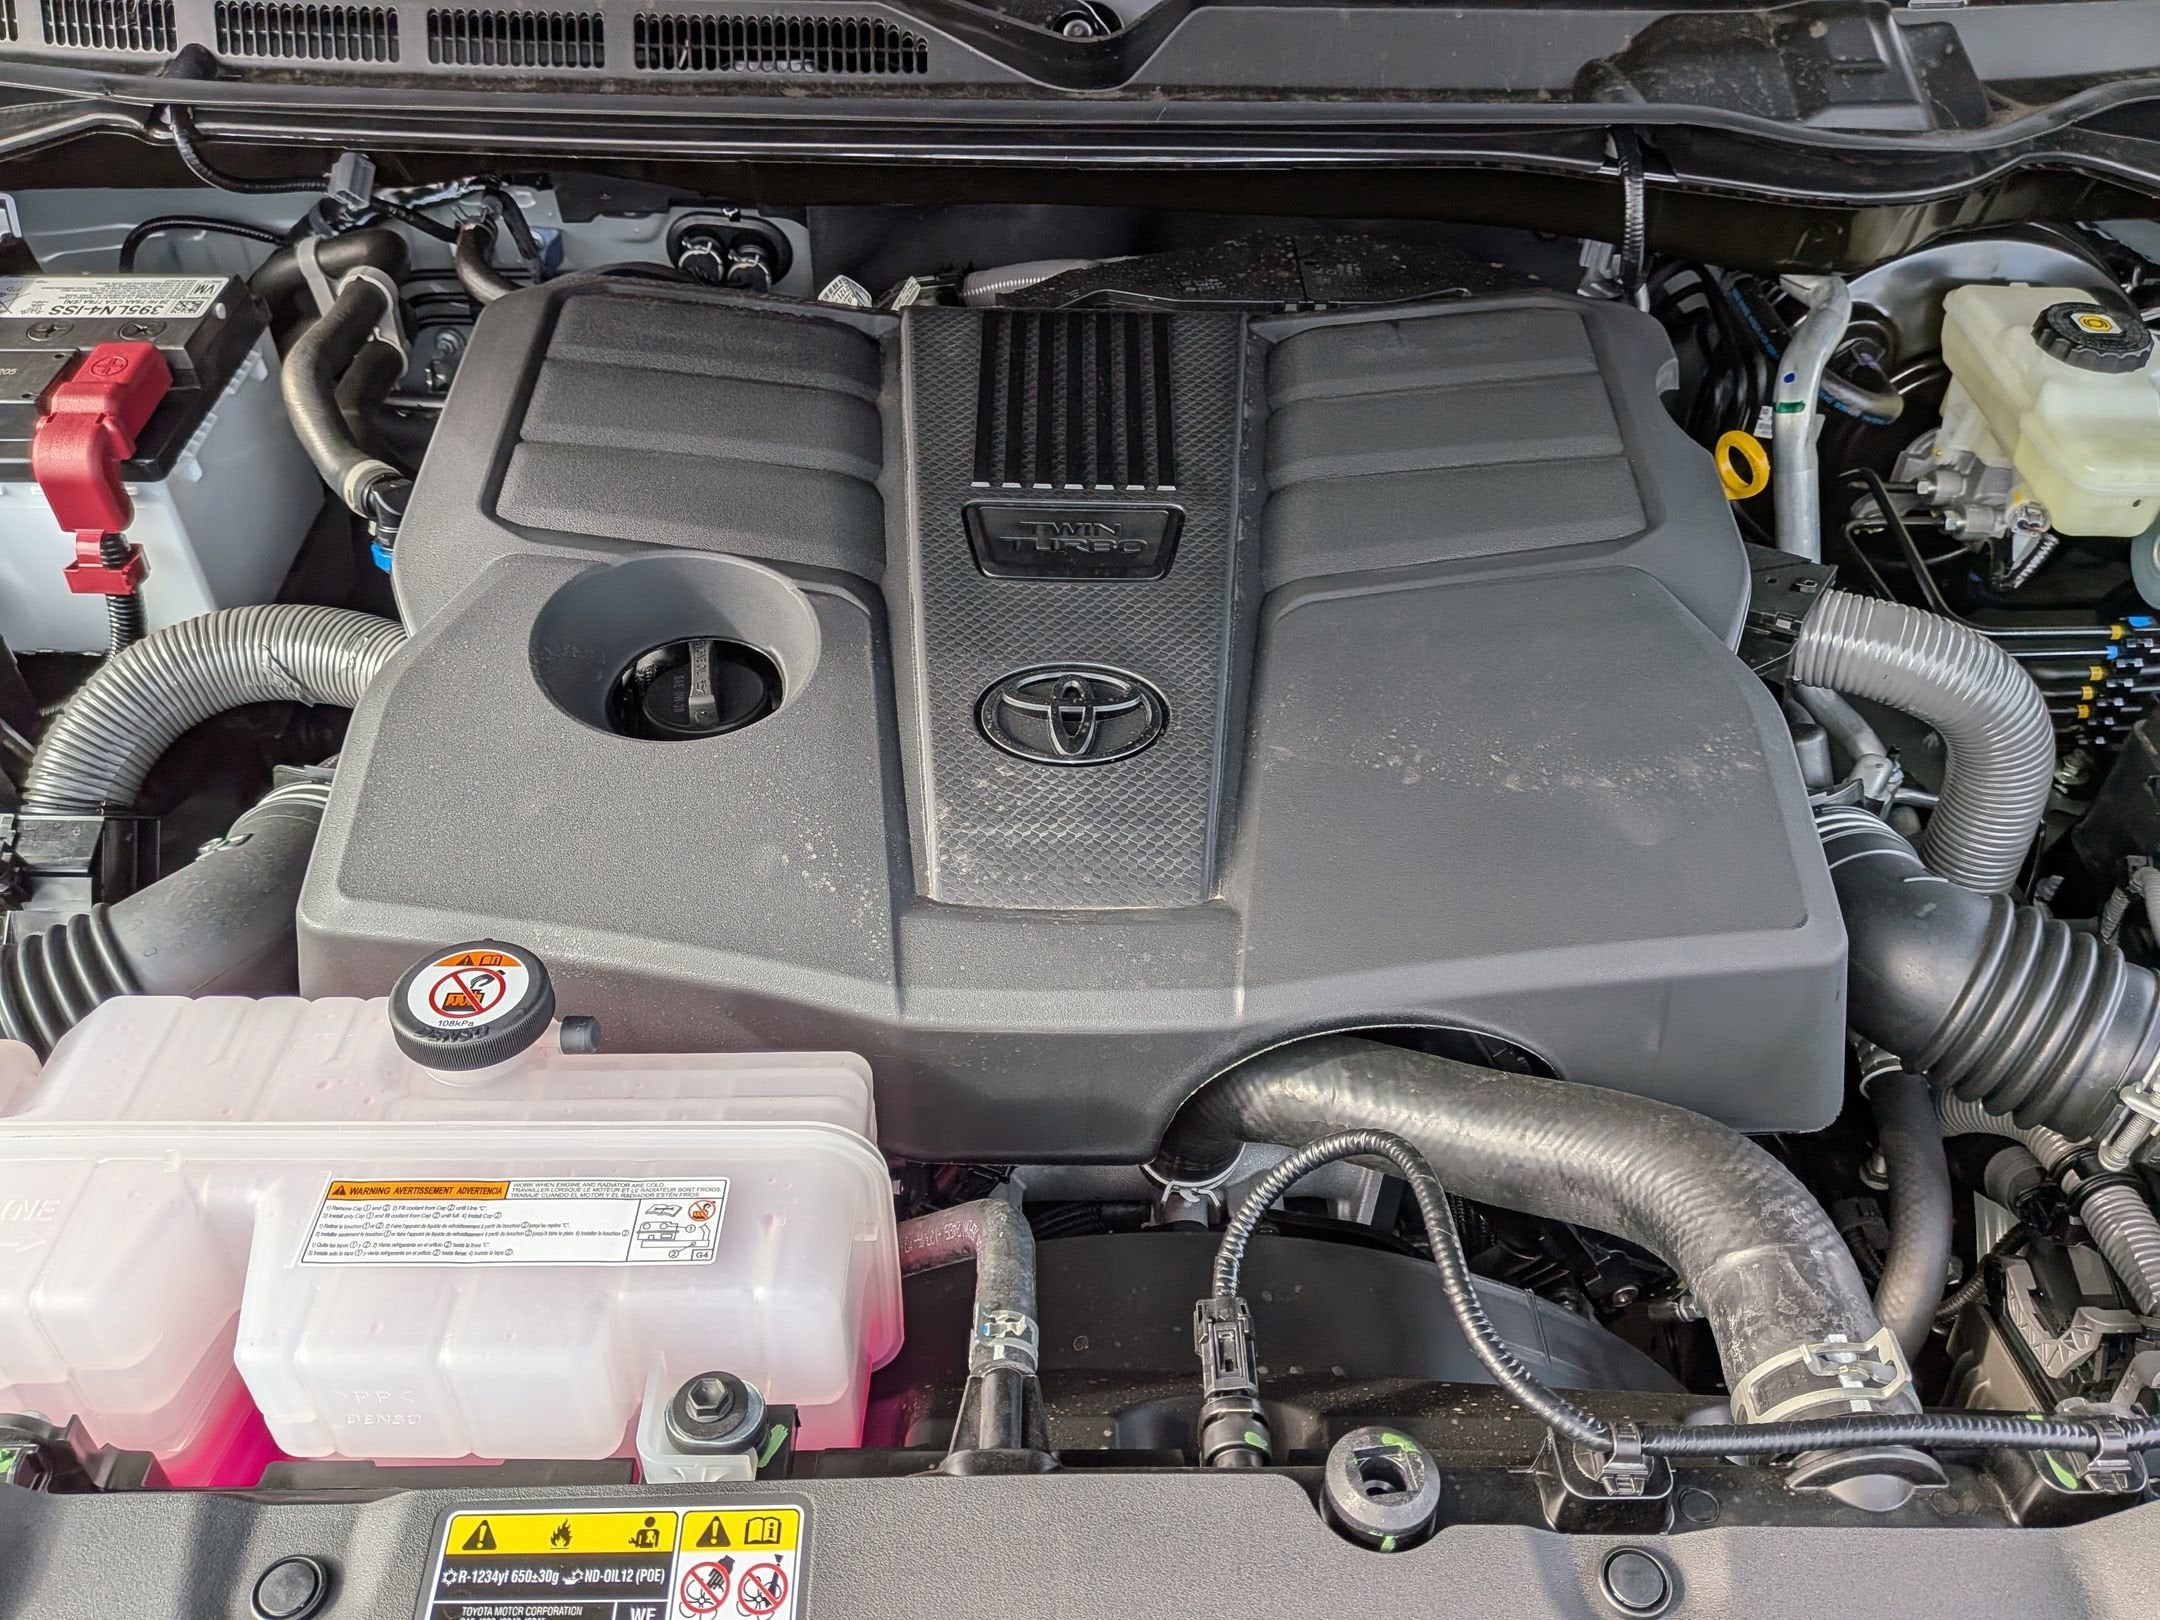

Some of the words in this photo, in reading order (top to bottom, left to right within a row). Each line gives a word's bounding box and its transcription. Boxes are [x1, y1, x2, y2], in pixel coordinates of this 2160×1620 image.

[195, 284, 215, 295] VM
[48, 305, 164, 316] 395LN4-ISS
[1019, 521, 1122, 538] TWIN
[438, 1019, 475, 1027] 108kPa
[350, 1186, 390, 1195] WARNING
[393, 1186, 453, 1195] AVERTISSEMENT
[456, 1186, 502, 1195] ADVERTENCIA
[695, 1251, 709, 1259] G4
[345, 1413, 422, 1425] DENSO
[457, 1568, 509, 1585] R-1234yf
[511, 1568, 560, 1585] 650±30g
[584, 1567, 633, 1583] ND-OIL12
[635, 1567, 665, 1585] (POE)
[462, 1607, 493, 1616] TOYOTA
[494, 1606, 524, 1616] MOTOR
[525, 1606, 583, 1616] CORPORATION
